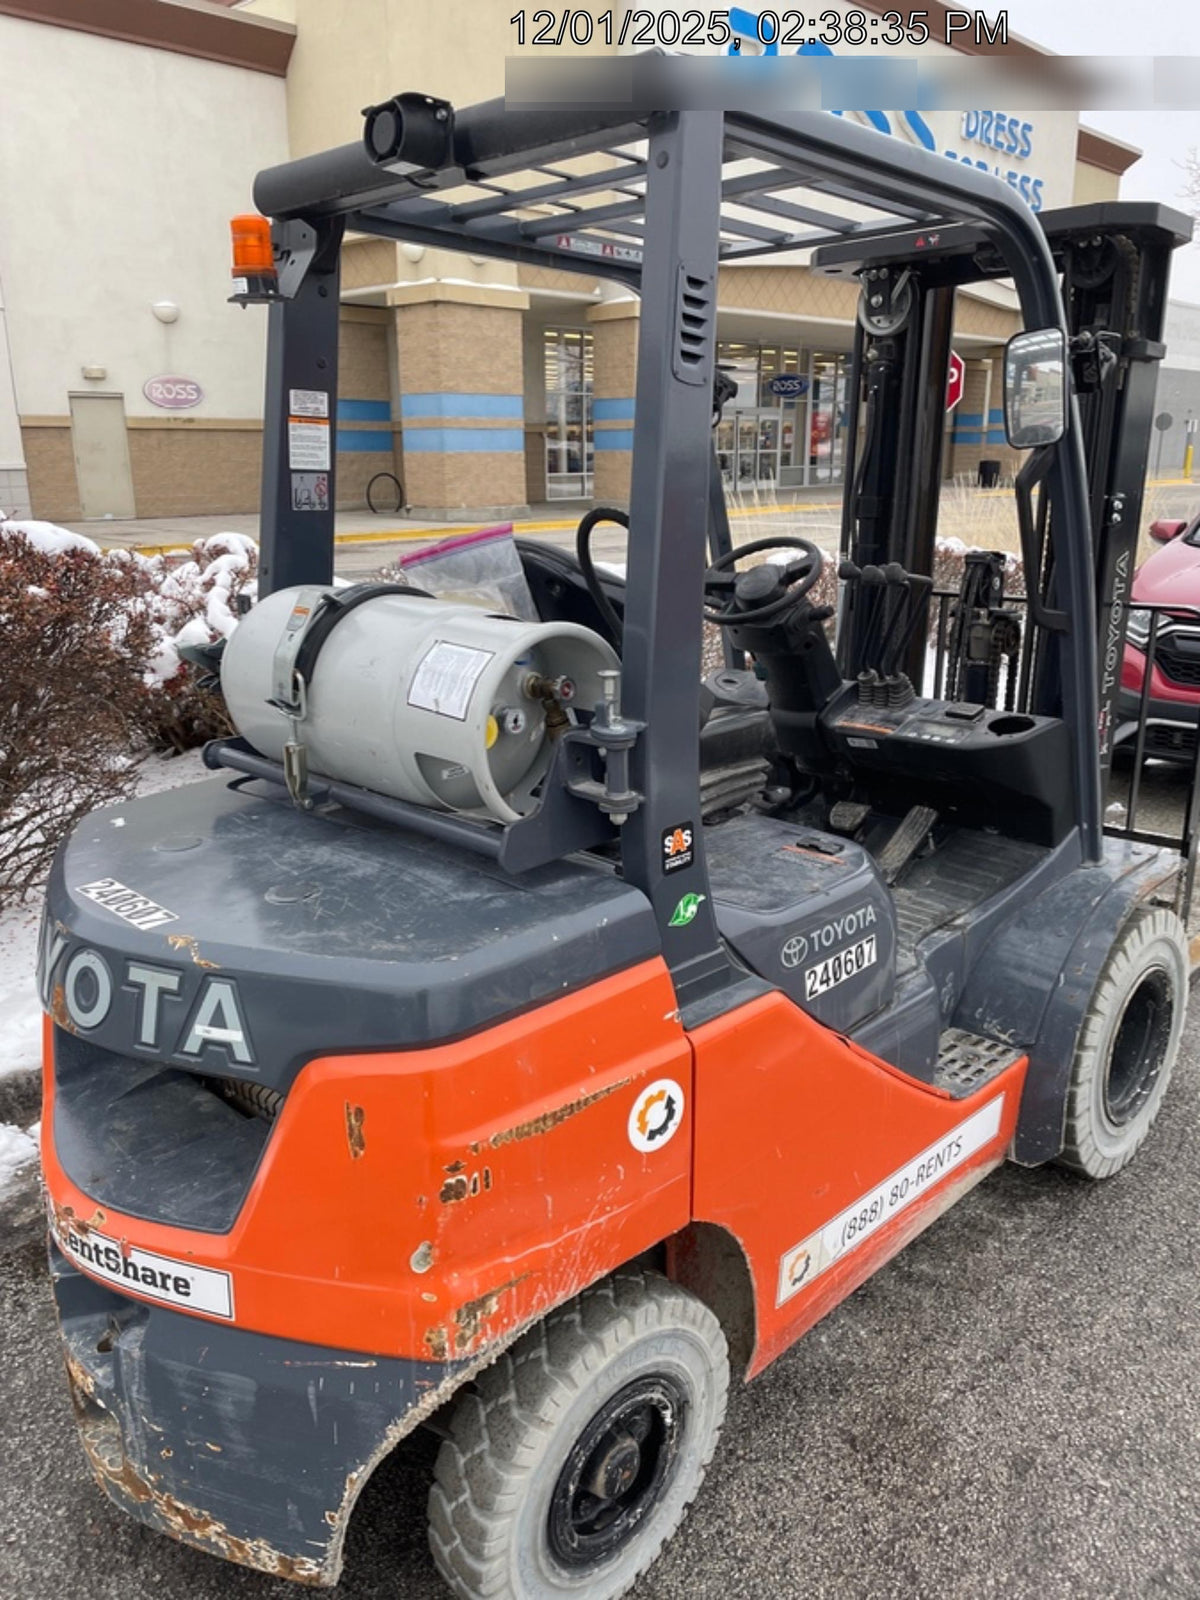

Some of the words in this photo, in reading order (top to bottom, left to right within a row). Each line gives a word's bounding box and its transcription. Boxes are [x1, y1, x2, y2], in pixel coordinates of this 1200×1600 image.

[963, 110, 1033, 159] DRESS
[152, 383, 199, 400] ROSS
[1102, 551, 1130, 694] TOYOTA
[664, 828, 693, 855] SAS
[79, 878, 176, 927] 240607
[810, 904, 877, 952] TOYOTA
[807, 936, 875, 999] 240607
[841, 1196, 885, 1247] (888)
[888, 1135, 964, 1207] 80-RENTS
[66, 1230, 192, 1297] entShare
